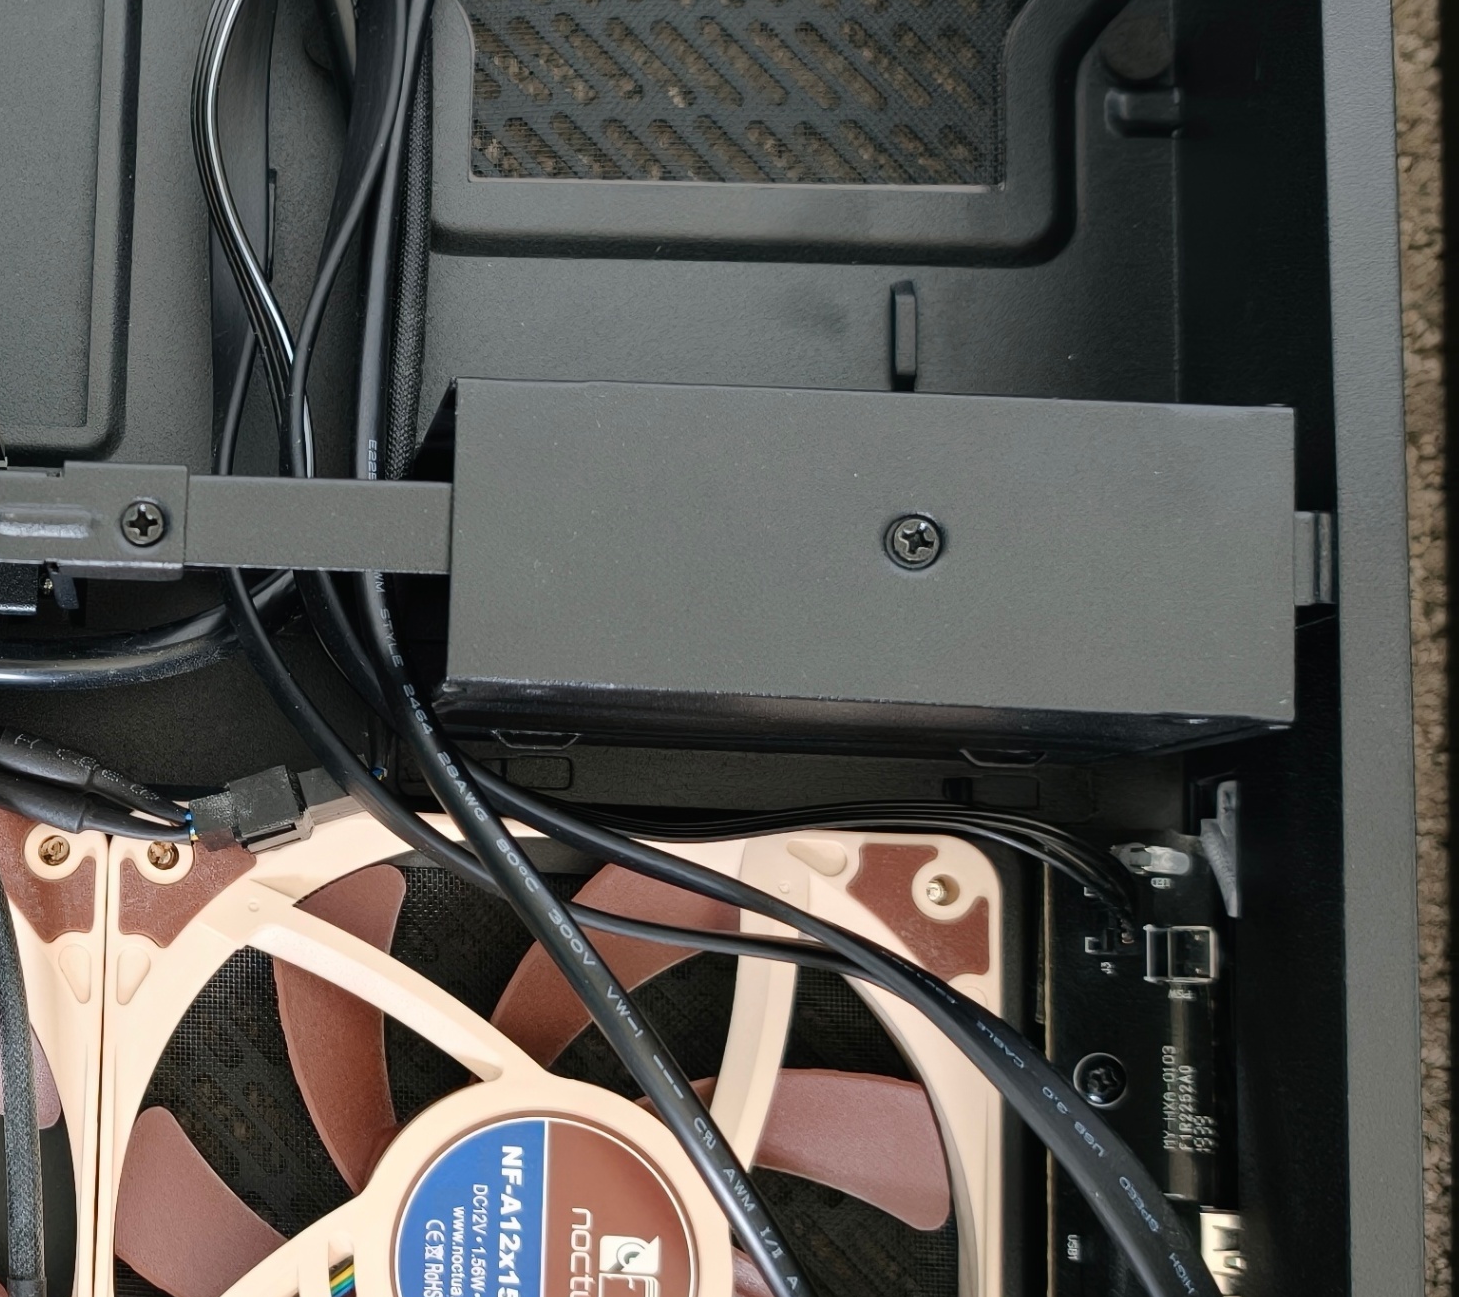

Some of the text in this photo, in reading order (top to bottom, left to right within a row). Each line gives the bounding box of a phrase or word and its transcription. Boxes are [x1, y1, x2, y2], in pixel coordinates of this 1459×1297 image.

[374, 570, 386, 594] WM
[380, 607, 405, 668] STYLE
[402, 683, 433, 735] 2464
[437, 751, 489, 822] 28AWG
[548, 908, 596, 966] 300V
[976, 1020, 1196, 1295] HIGH SPEED USB 3.0 CABLE
[472, 1184, 487, 1234] DC12V
[723, 1167, 755, 1212] AWM
[786, 1275, 798, 1290] A
[1067, 1234, 1081, 1262] USB1
[470, 1247, 487, 1291] 1.56W
